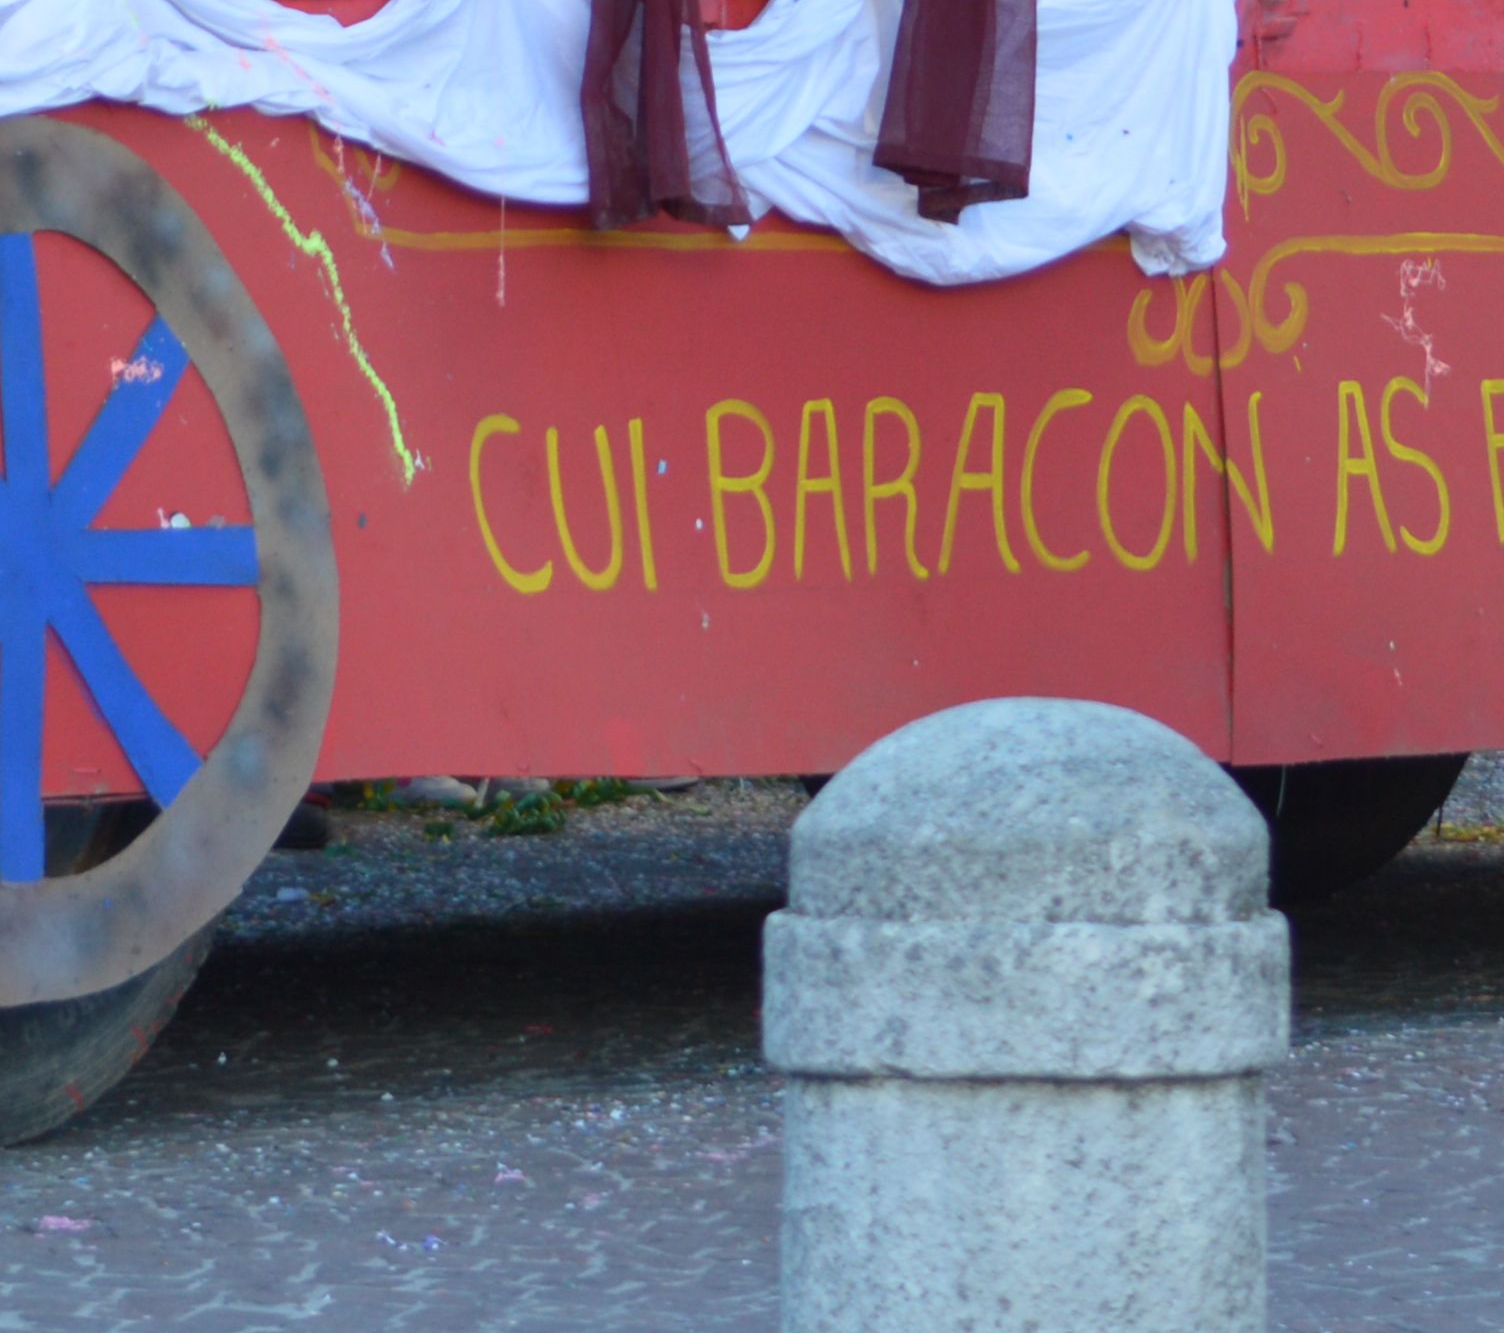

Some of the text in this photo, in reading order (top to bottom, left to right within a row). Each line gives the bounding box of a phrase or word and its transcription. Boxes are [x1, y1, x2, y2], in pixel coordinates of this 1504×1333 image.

[468, 412, 659, 596] CUI
[704, 387, 1276, 591] BARACON
[1332, 375, 1453, 558] AS
